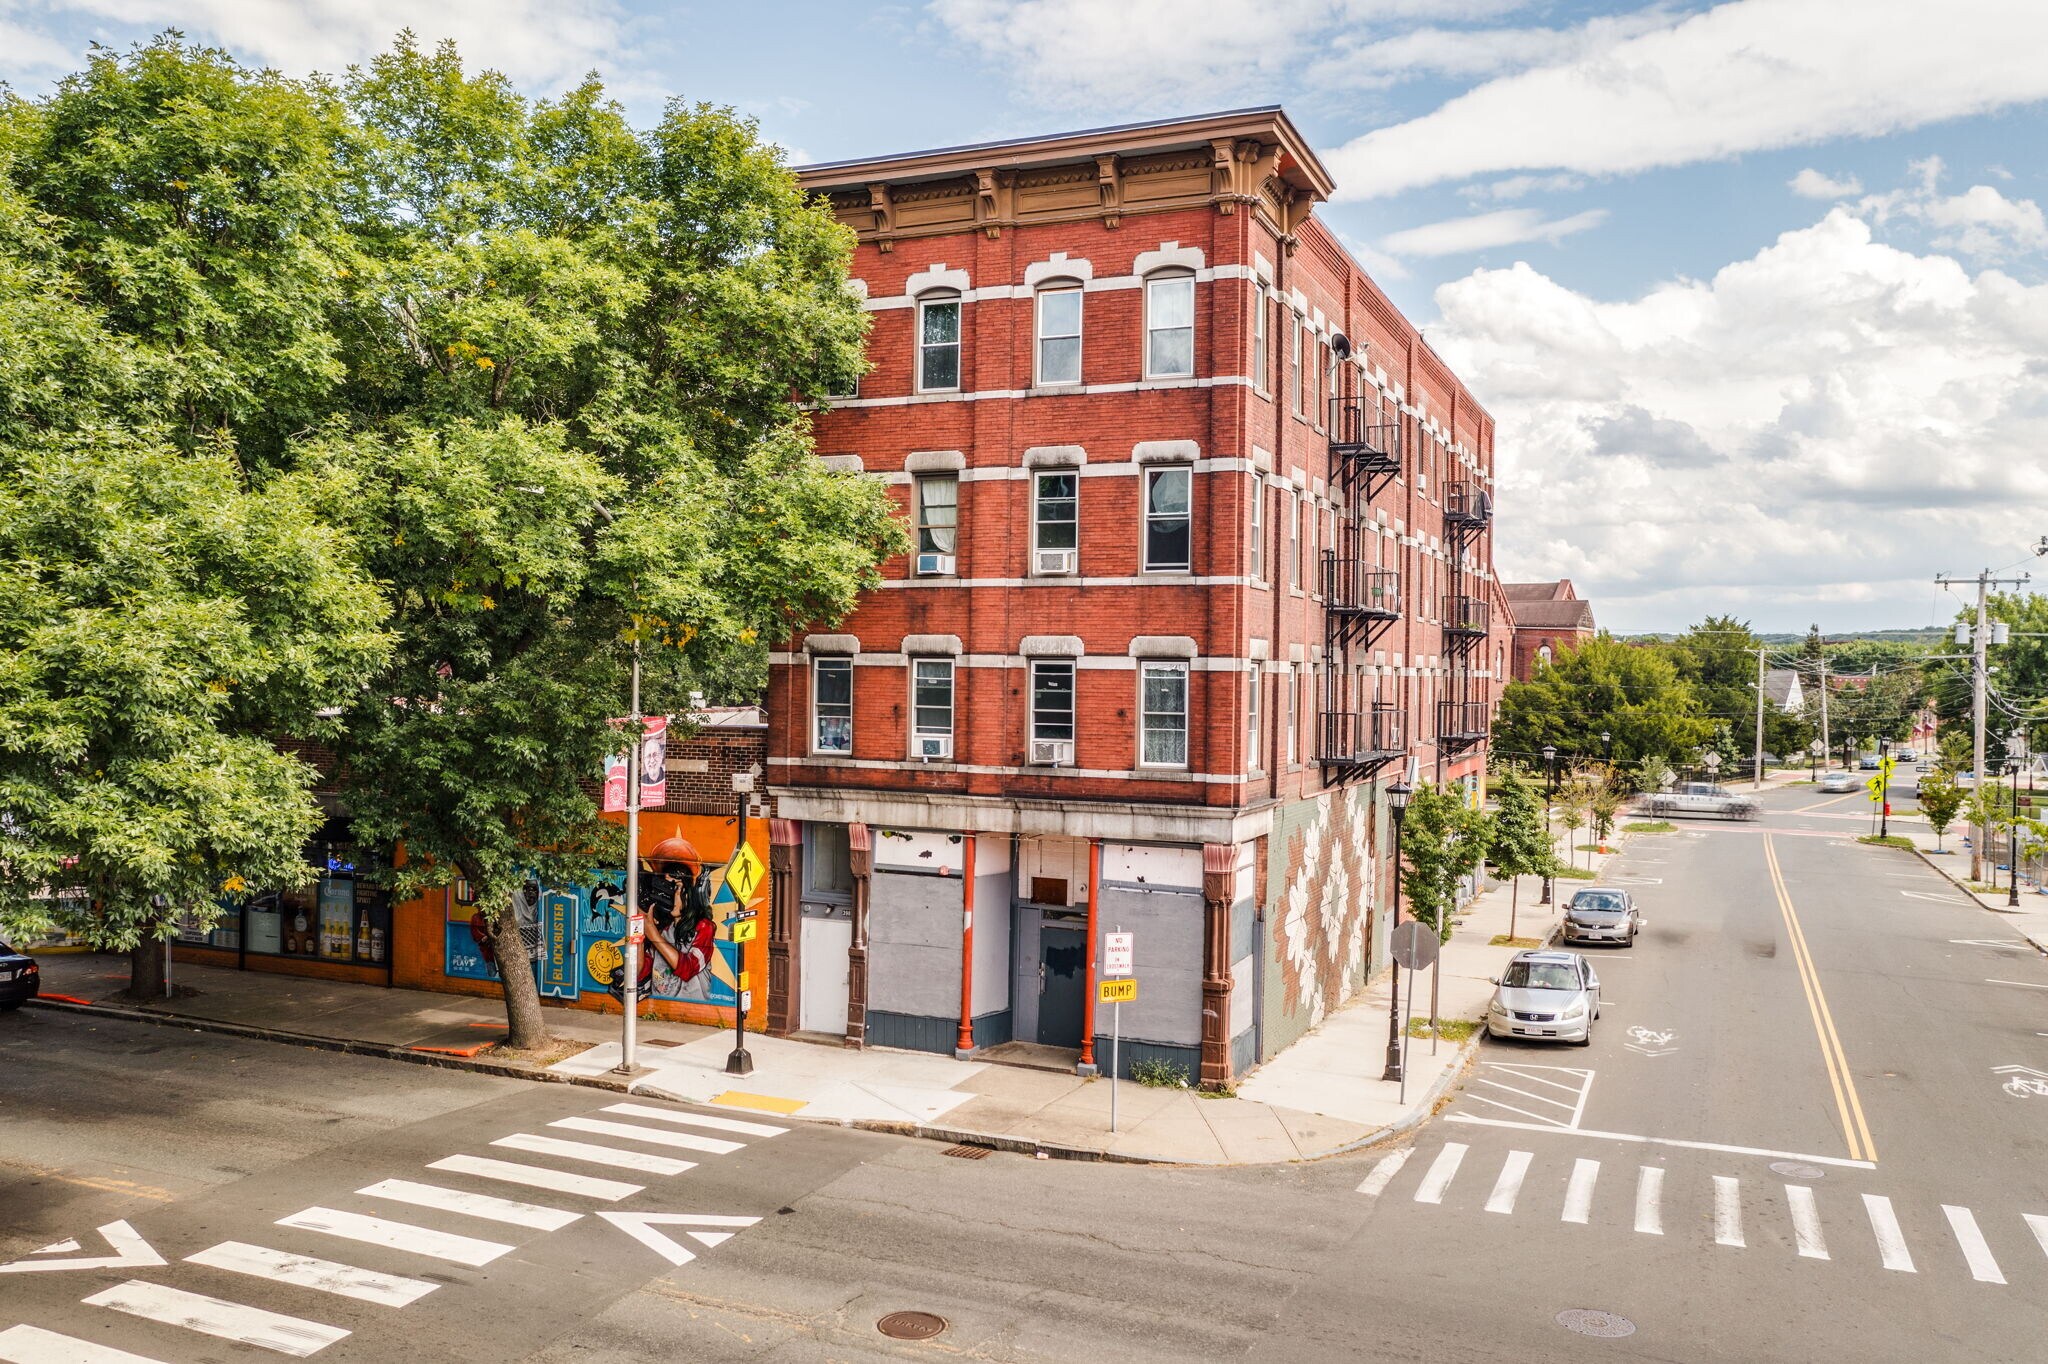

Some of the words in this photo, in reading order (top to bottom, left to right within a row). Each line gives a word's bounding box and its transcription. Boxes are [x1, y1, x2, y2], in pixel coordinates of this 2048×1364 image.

[323, 886, 350, 897] Corona
[553, 903, 564, 980] BLOCKBUSTER
[595, 942, 604, 951] BE
[453, 959, 469, 967] PLAY
[588, 959, 611, 982] REWIND
[1103, 985, 1132, 998] BUMP
